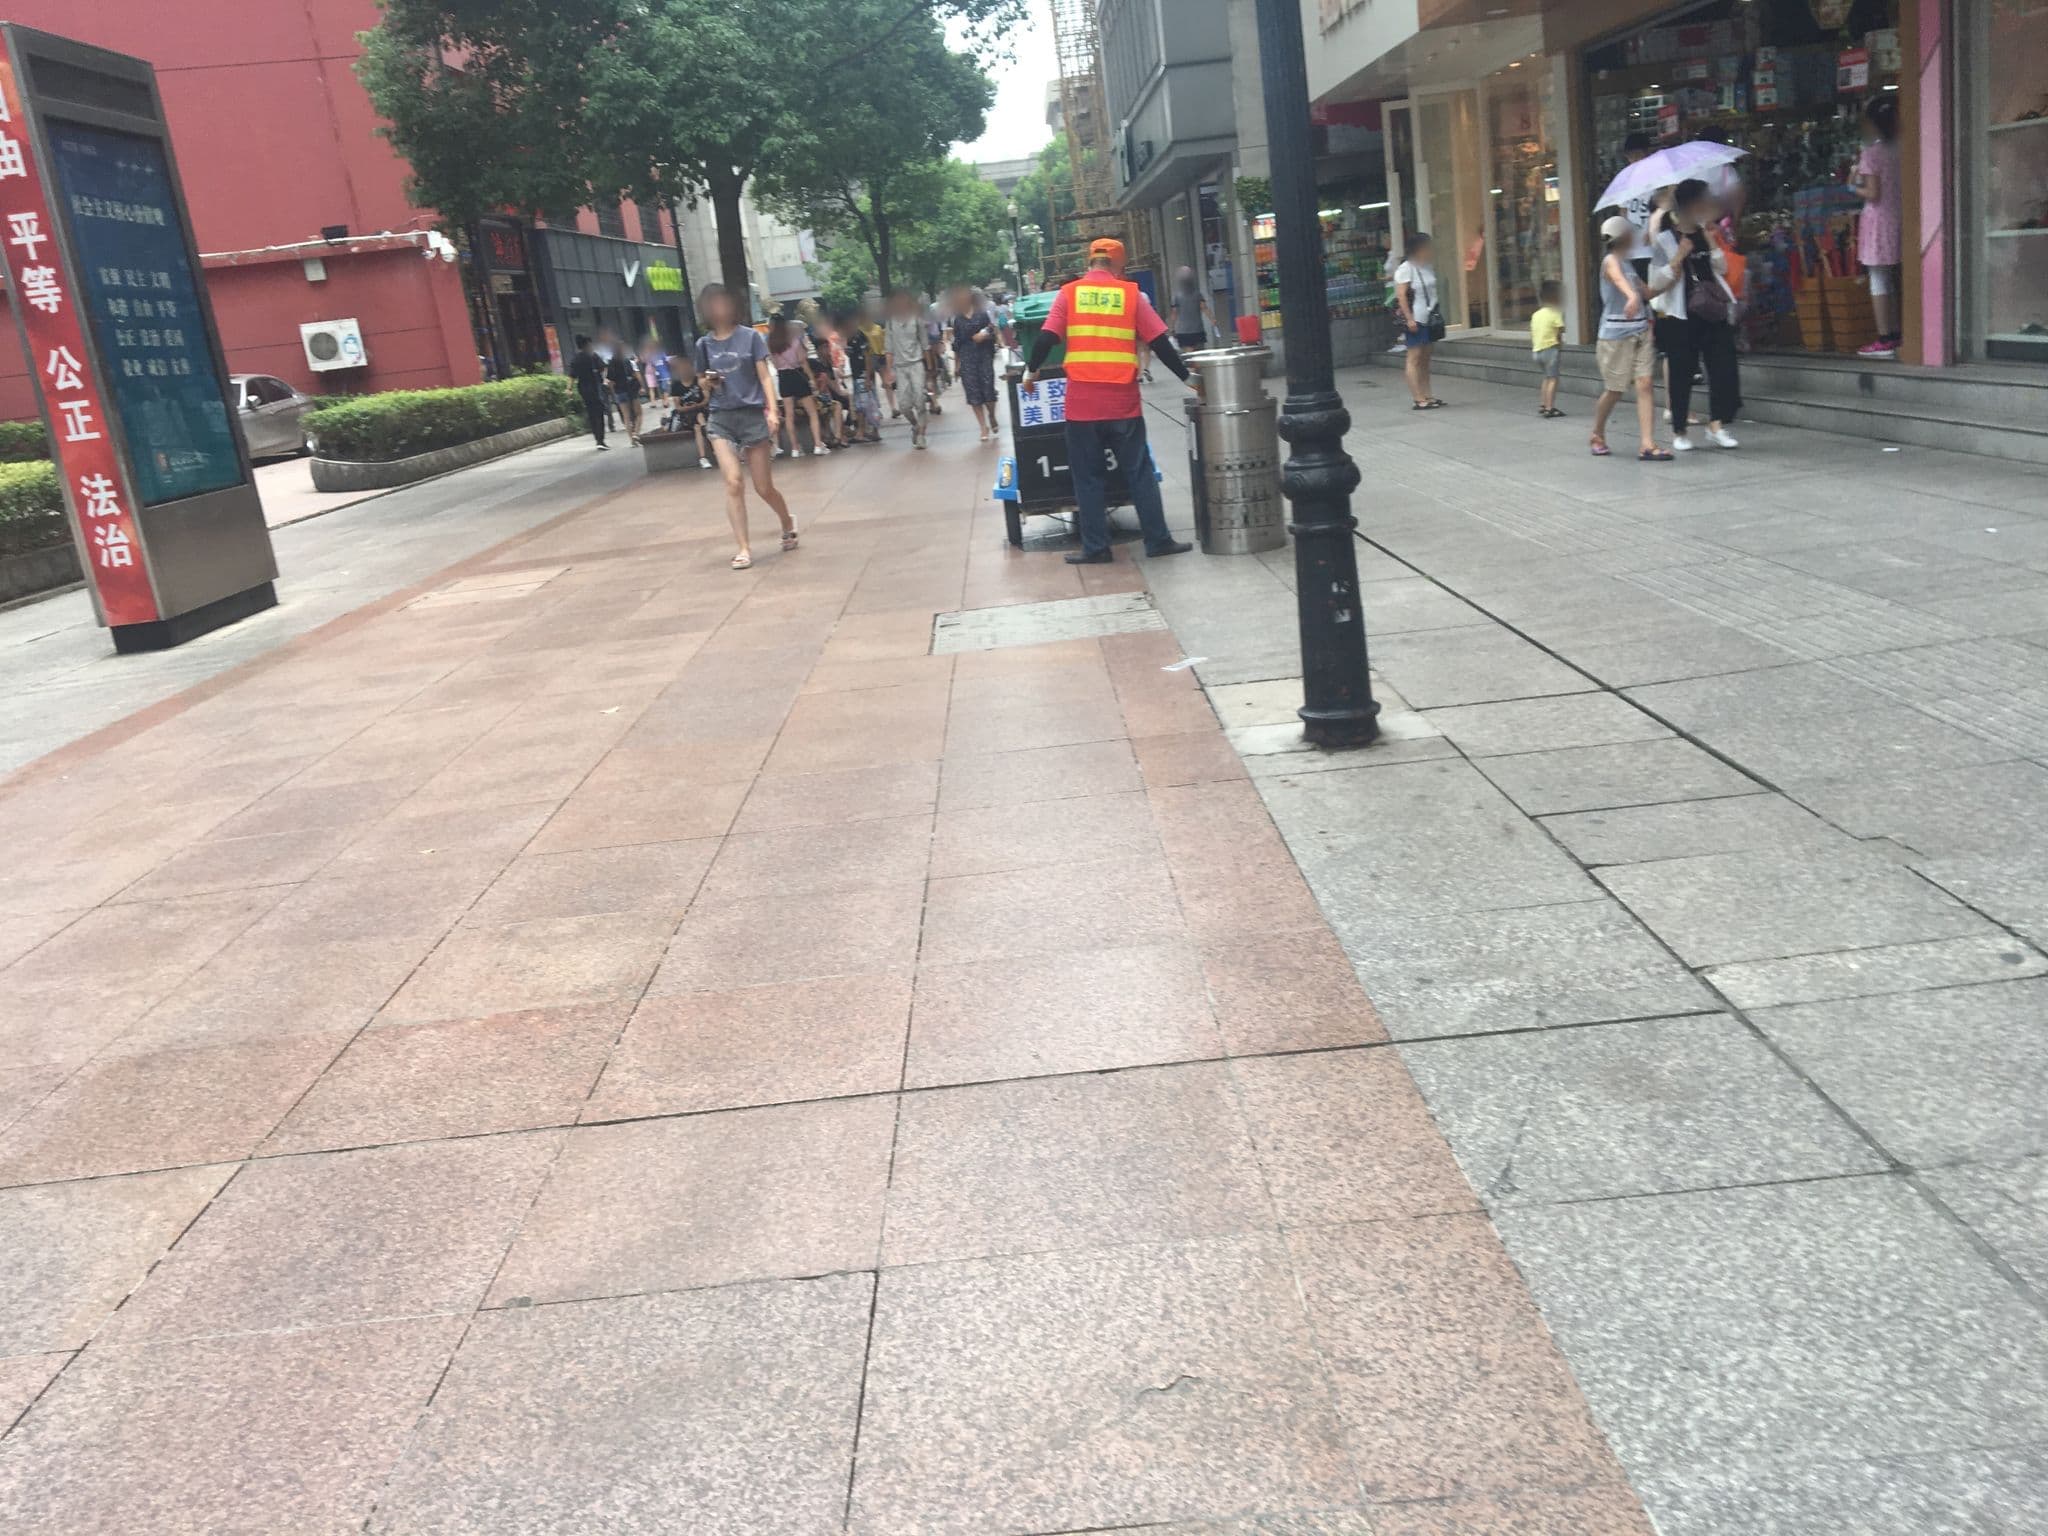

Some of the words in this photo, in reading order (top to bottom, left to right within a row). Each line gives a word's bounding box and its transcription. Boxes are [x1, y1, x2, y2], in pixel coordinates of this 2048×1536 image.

[7, 211, 63, 314] 平等
[46, 345, 101, 442] 公正
[80, 472, 133, 568] 法治
